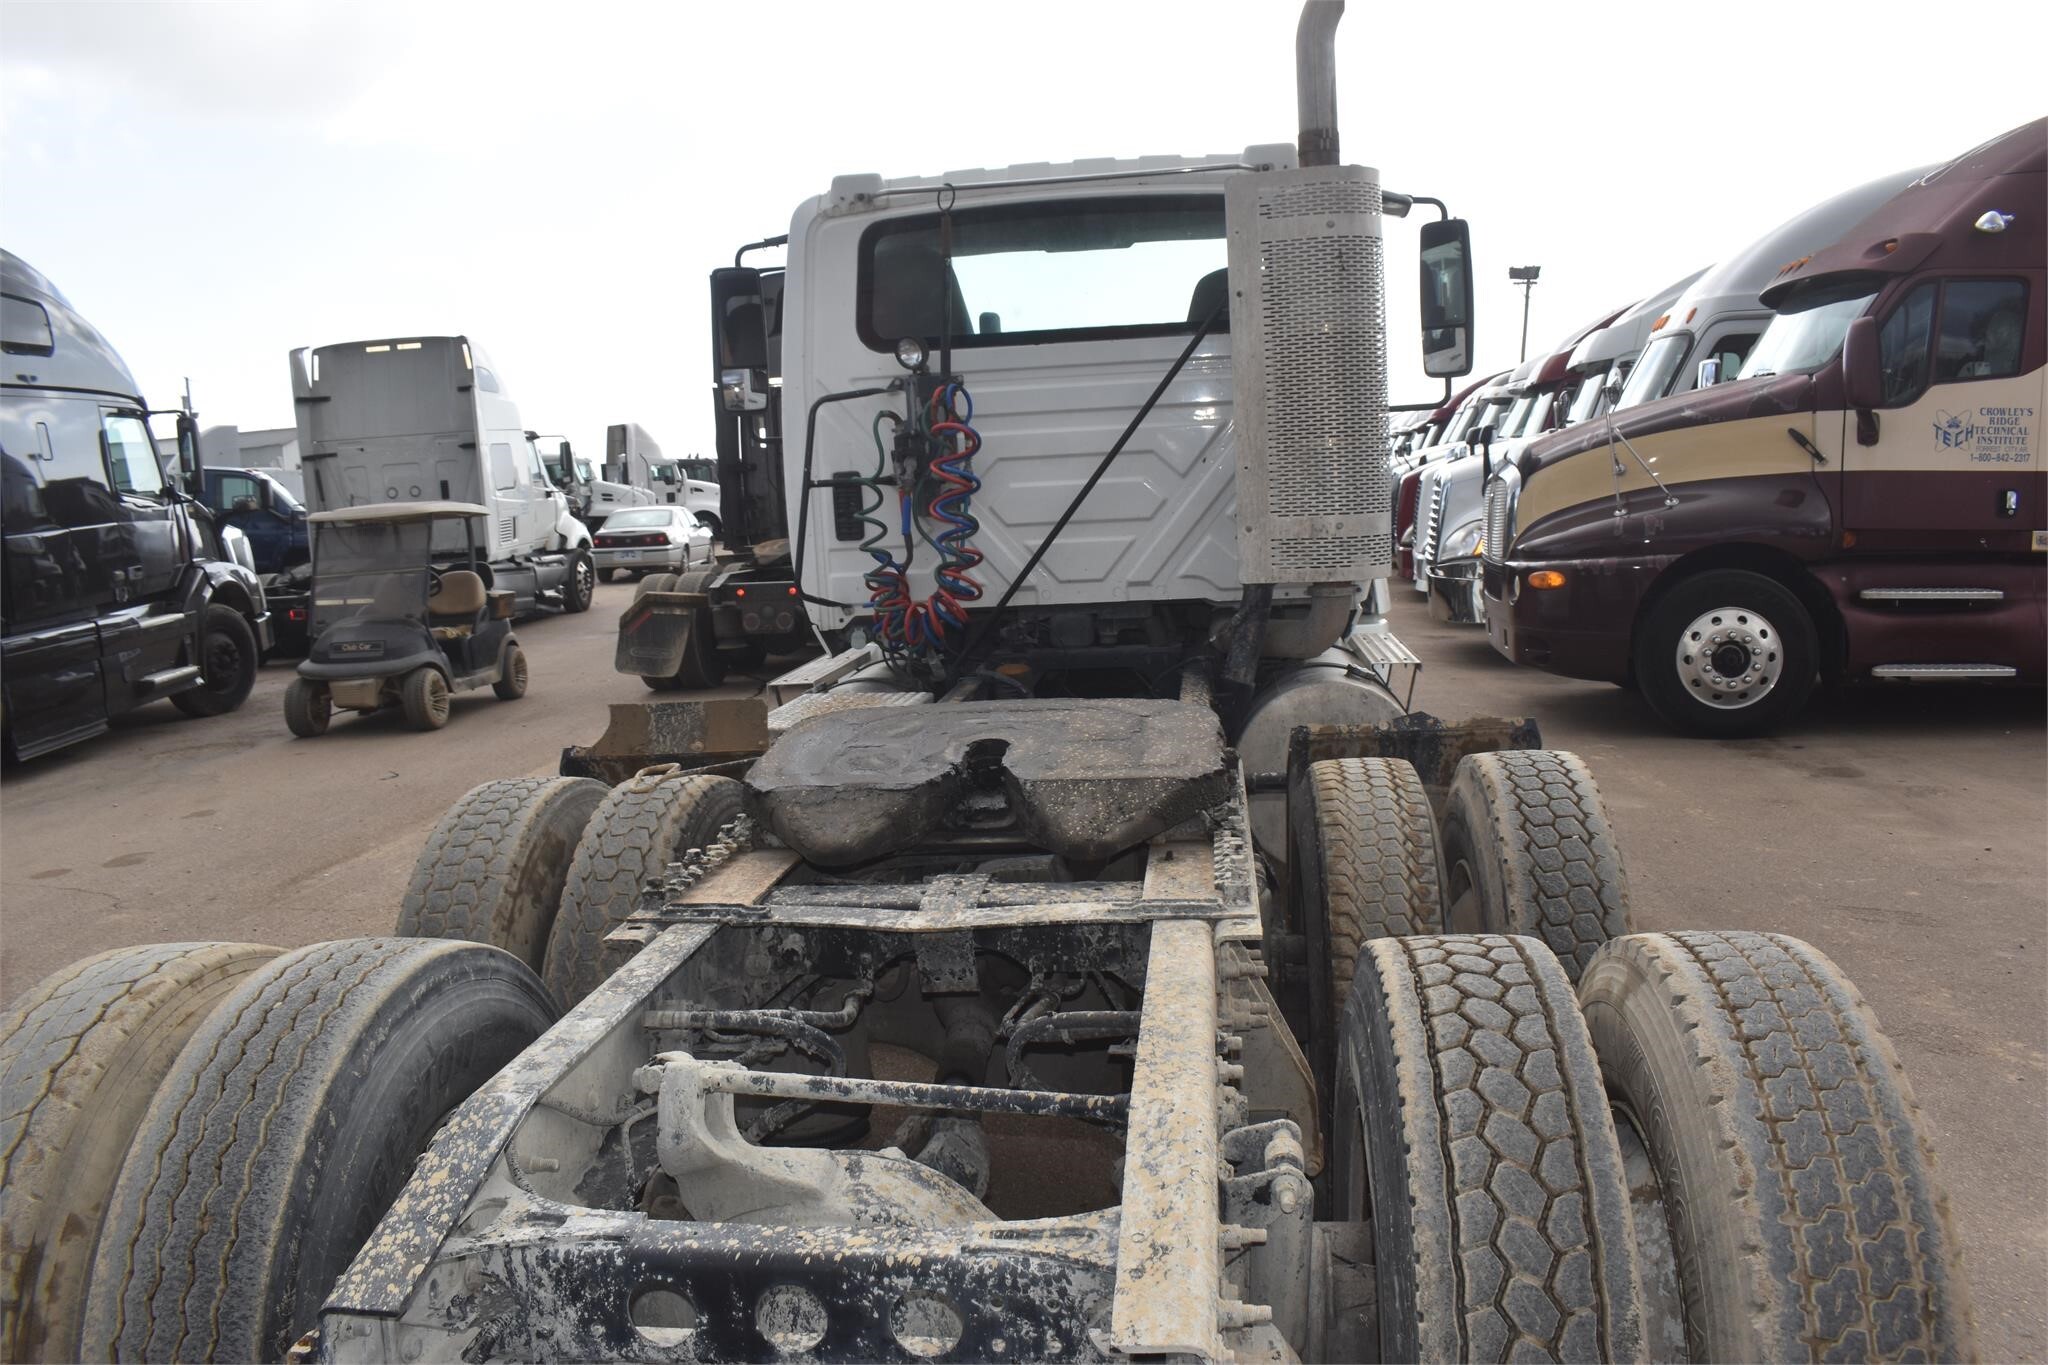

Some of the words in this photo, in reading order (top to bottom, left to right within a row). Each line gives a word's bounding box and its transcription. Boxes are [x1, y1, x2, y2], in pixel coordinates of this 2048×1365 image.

[1979, 407, 2033, 416] CROWLEY'S
[1989, 416, 2020, 425] RIDGE
[1932, 423, 1974, 447] TECH
[1975, 426, 2029, 435] TECHNICAL
[1977, 436, 2027, 445] INSTITUTE
